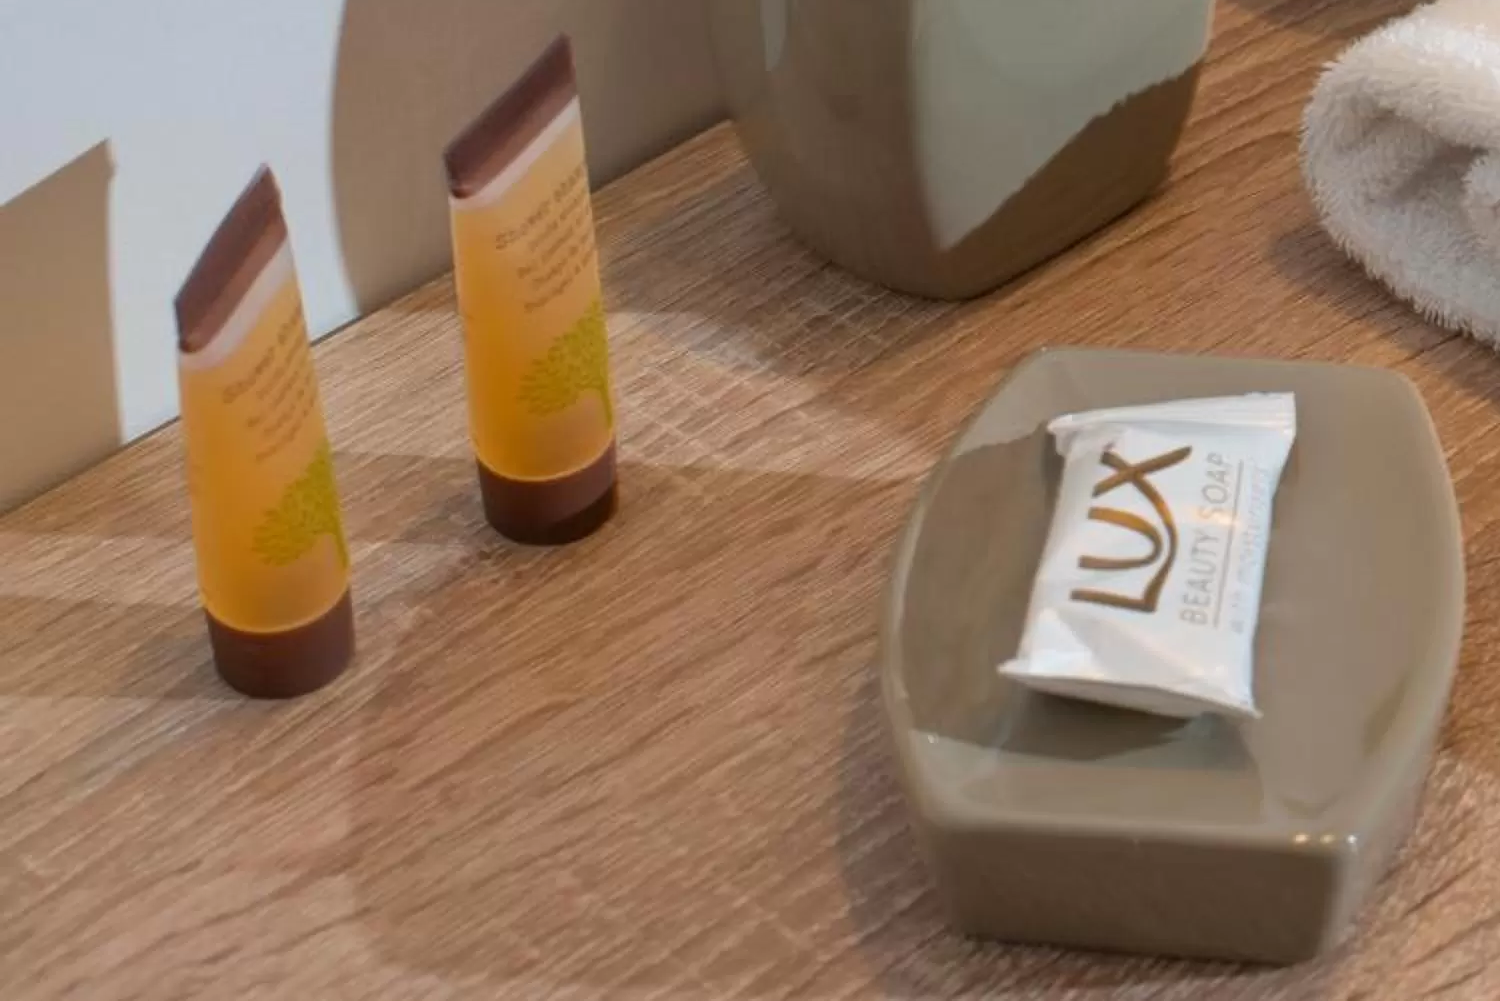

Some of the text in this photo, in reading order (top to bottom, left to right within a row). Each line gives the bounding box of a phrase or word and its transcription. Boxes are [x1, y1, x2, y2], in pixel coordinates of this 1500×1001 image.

[1069, 445, 1192, 613] LUX
[1179, 451, 1233, 625] BEAUTY SOAP
